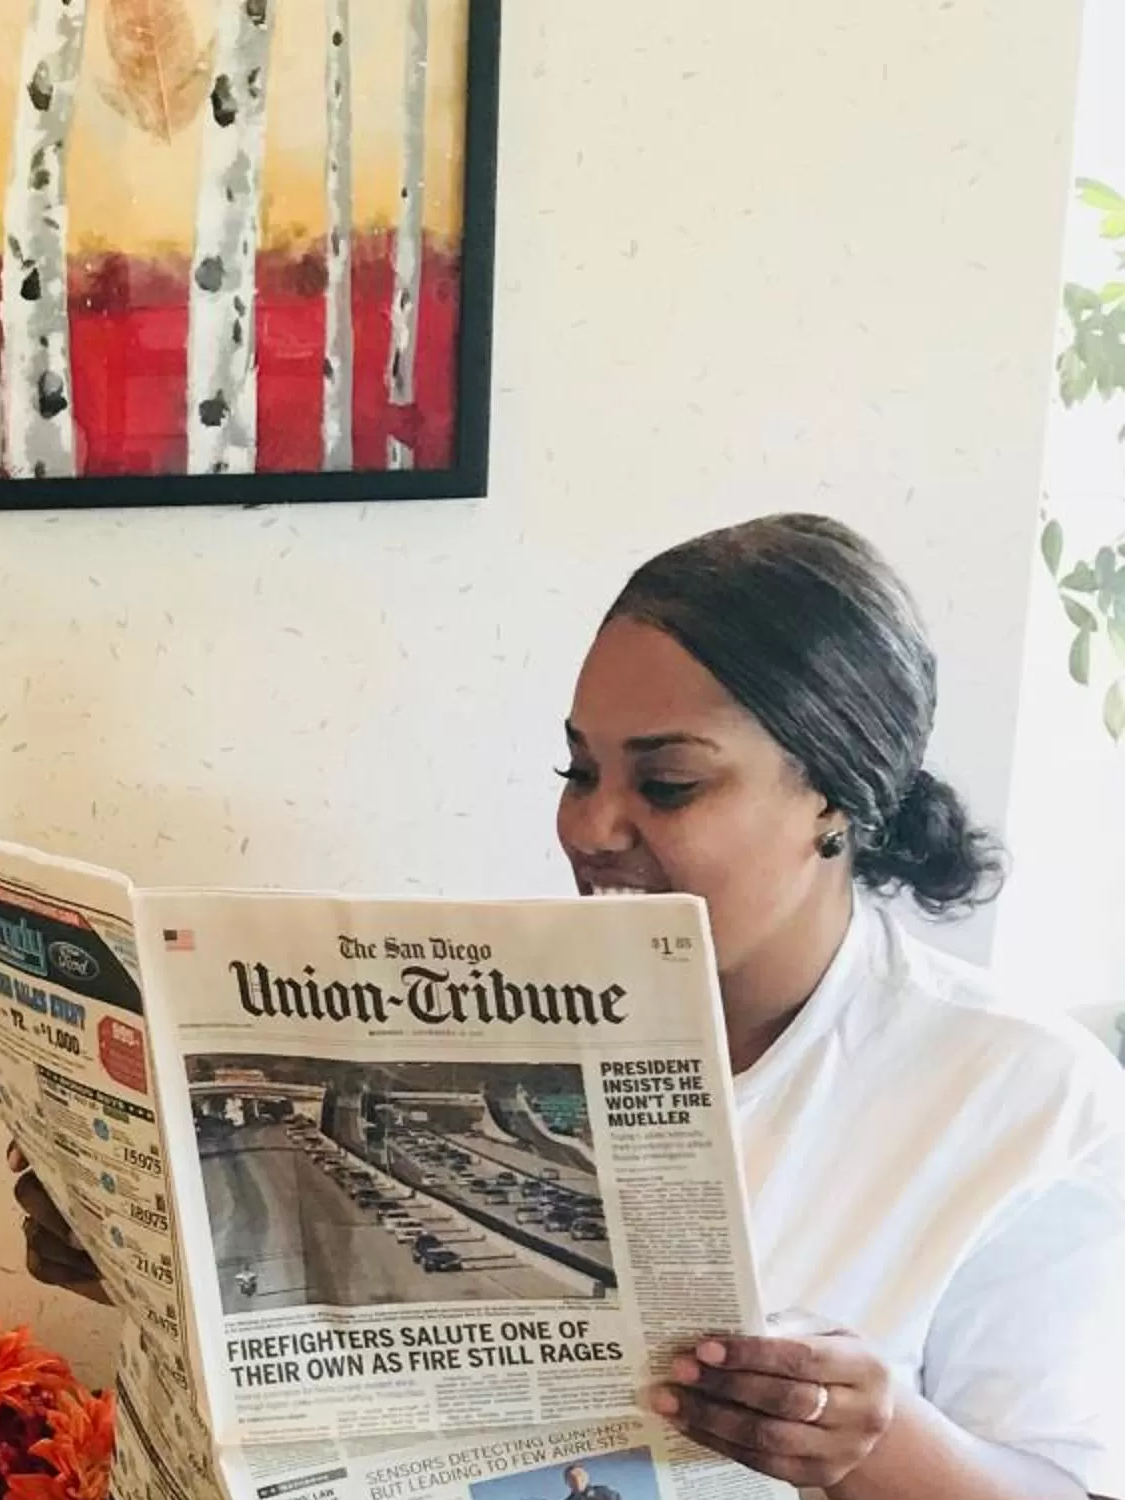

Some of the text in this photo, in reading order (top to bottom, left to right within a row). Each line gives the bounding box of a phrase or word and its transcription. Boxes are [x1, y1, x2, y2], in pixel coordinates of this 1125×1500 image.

[338, 934, 493, 965] The San Diego
[228, 959, 629, 1026] Union-Tribune
[600, 1059, 702, 1077] PRESIDENT
[603, 1076, 704, 1094] INSISTS HE
[605, 1093, 712, 1111] WON'T FIRE
[607, 1111, 691, 1127] MUELLER
[226, 1320, 589, 1363] FIREFIGHTERS SALUTE ONE OF
[230, 1342, 624, 1388] THEIR OWN AS FIRE STILL RAGES
[366, 1455, 445, 1485] SENSORS
[448, 1439, 545, 1467] DETECTING
[548, 1422, 643, 1445] GUNSHOTS
[370, 1434, 630, 1500] BUT LEADING TO FEW ARRESTS
